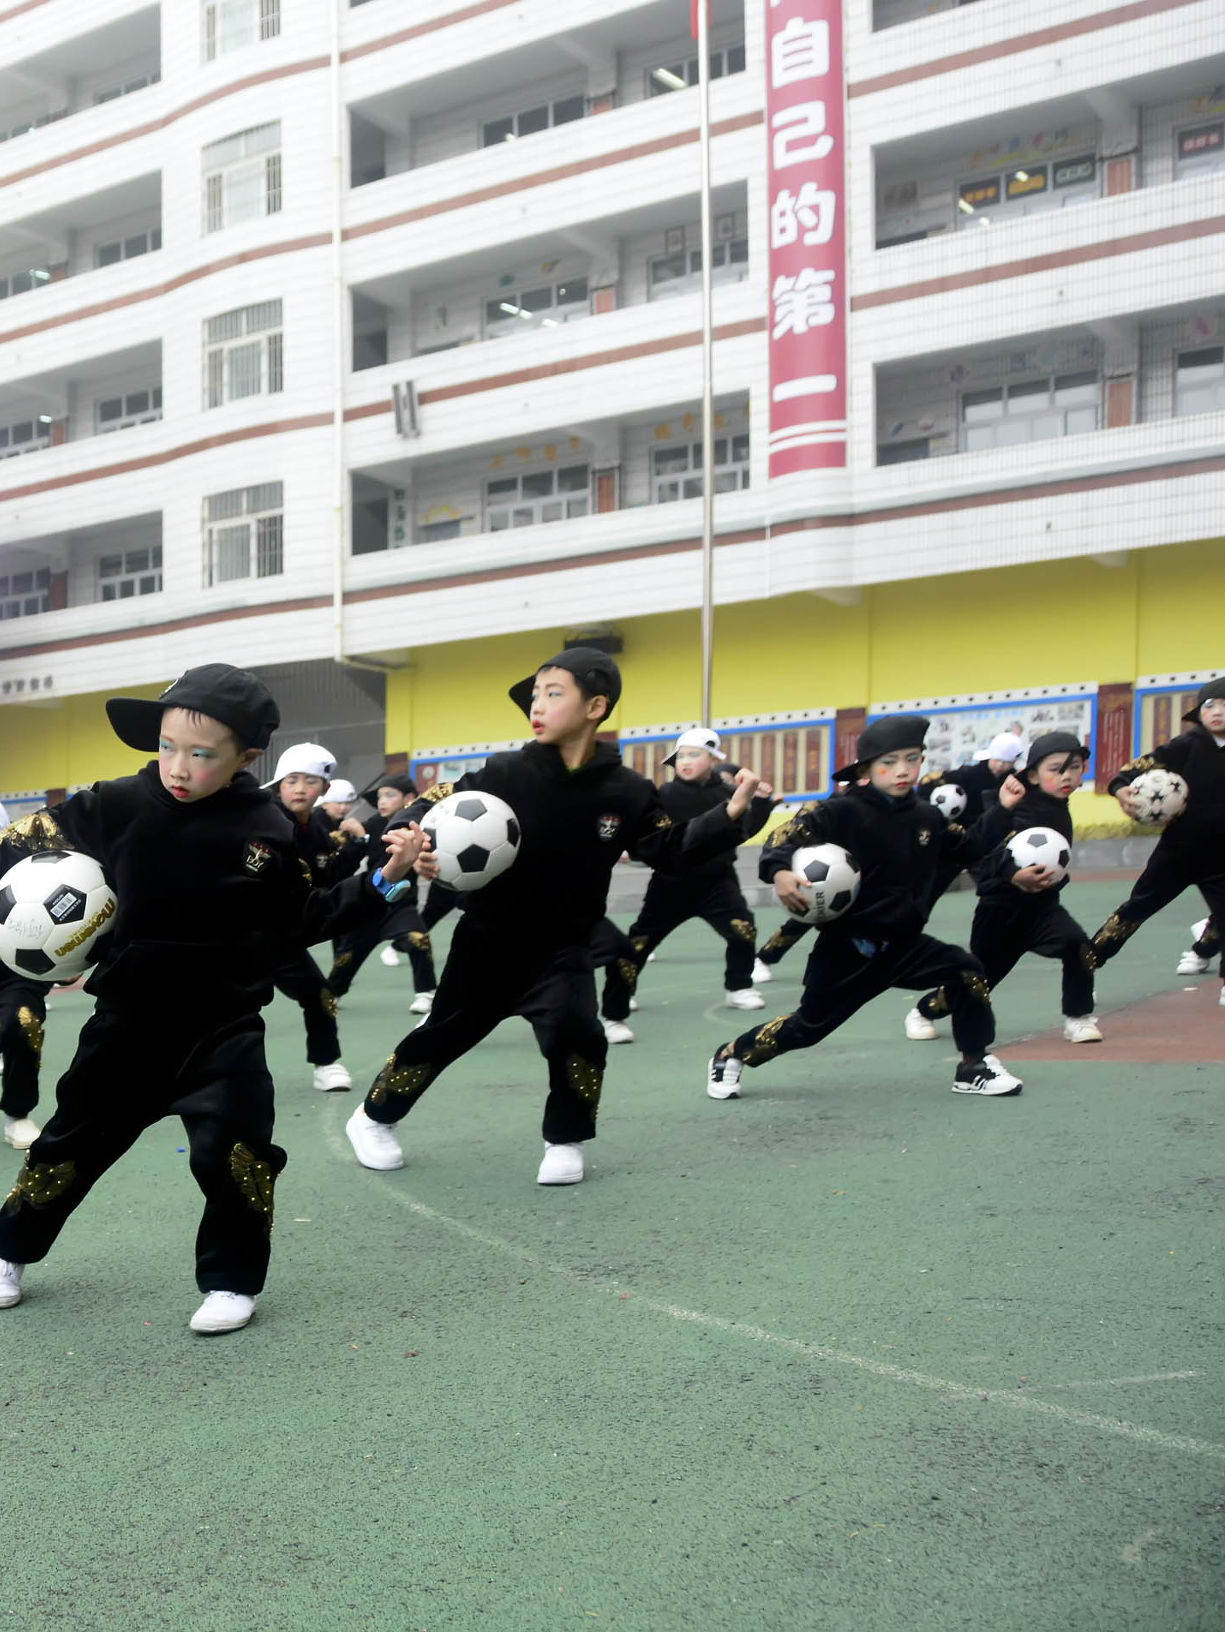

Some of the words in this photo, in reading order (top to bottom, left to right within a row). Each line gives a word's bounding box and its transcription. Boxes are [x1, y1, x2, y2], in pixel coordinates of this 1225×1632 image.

[770, 0, 838, 403] 自己的第一
